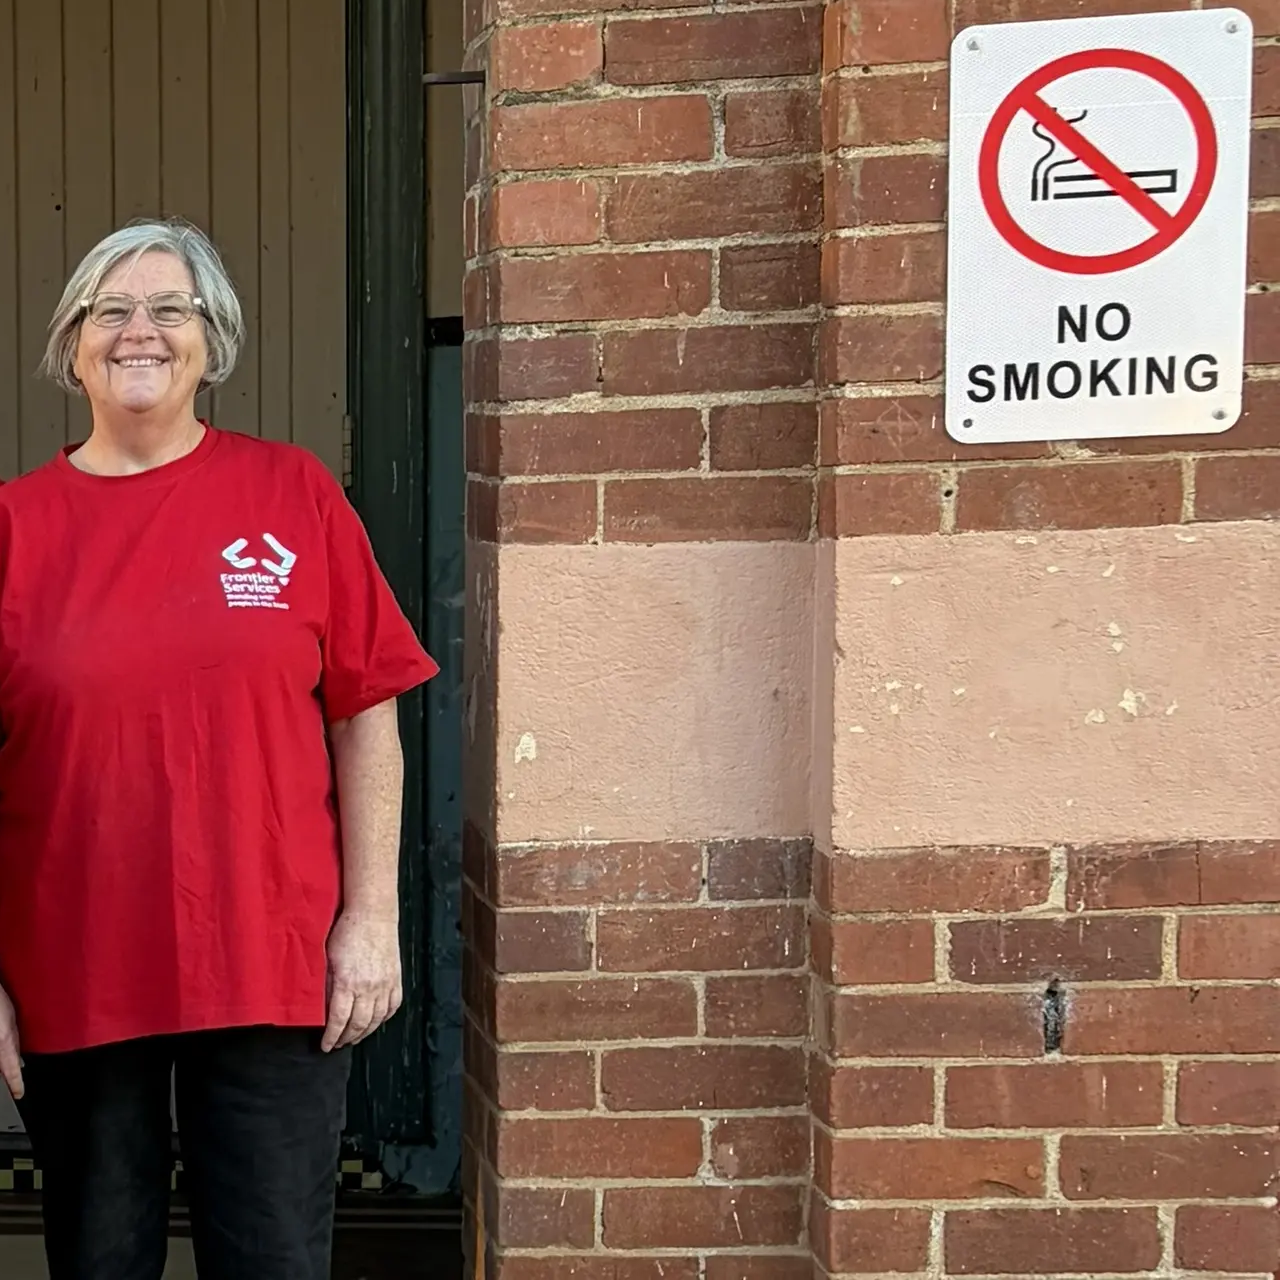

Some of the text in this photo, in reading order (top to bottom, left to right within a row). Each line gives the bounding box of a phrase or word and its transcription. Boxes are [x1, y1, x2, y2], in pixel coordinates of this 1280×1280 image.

[1057, 302, 1131, 344] NO
[966, 353, 1219, 403] SMOKING
[220, 572, 275, 584] Frontier
[224, 582, 281, 594] Services
